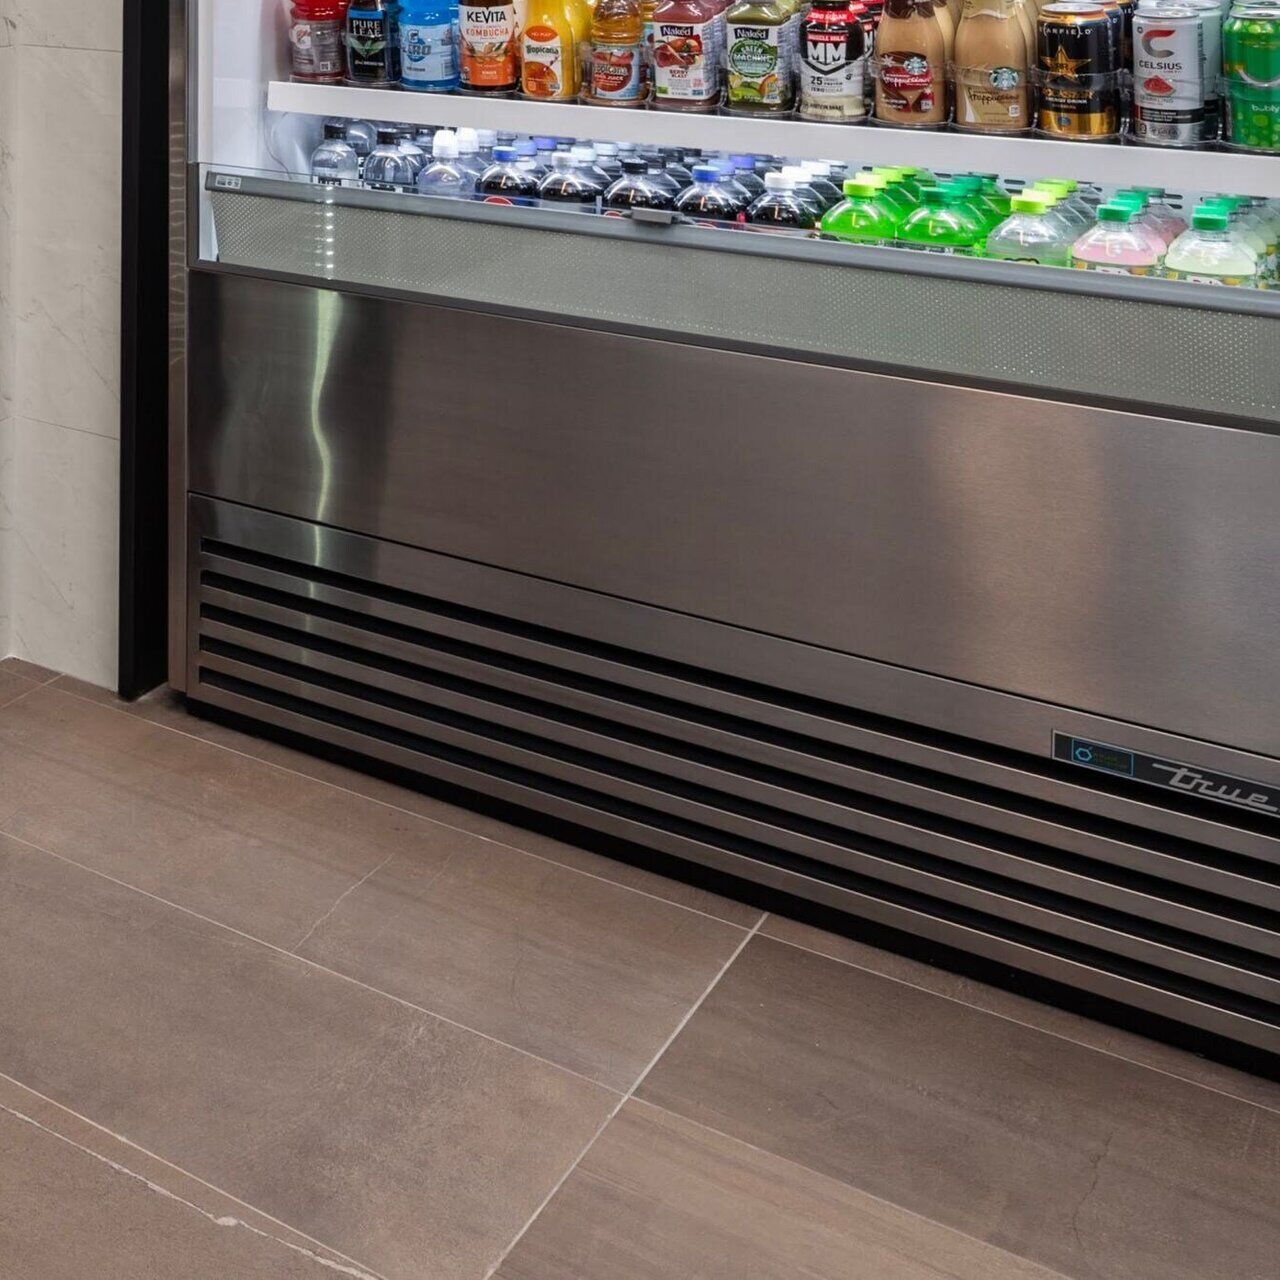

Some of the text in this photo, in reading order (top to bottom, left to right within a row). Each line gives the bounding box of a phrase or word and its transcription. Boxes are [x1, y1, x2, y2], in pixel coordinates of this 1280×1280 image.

[352, 20, 381, 29] PURE
[467, 27, 510, 37] KOMBUCHA
[662, 26, 692, 37] Naked
[736, 29, 767, 39] Naked
[526, 45, 559, 55] Tropicana
[807, 41, 847, 65] MM
[1139, 61, 1182, 71] CELSIUS
[811, 76, 823, 86] 25
[1153, 763, 1279, 813] true
